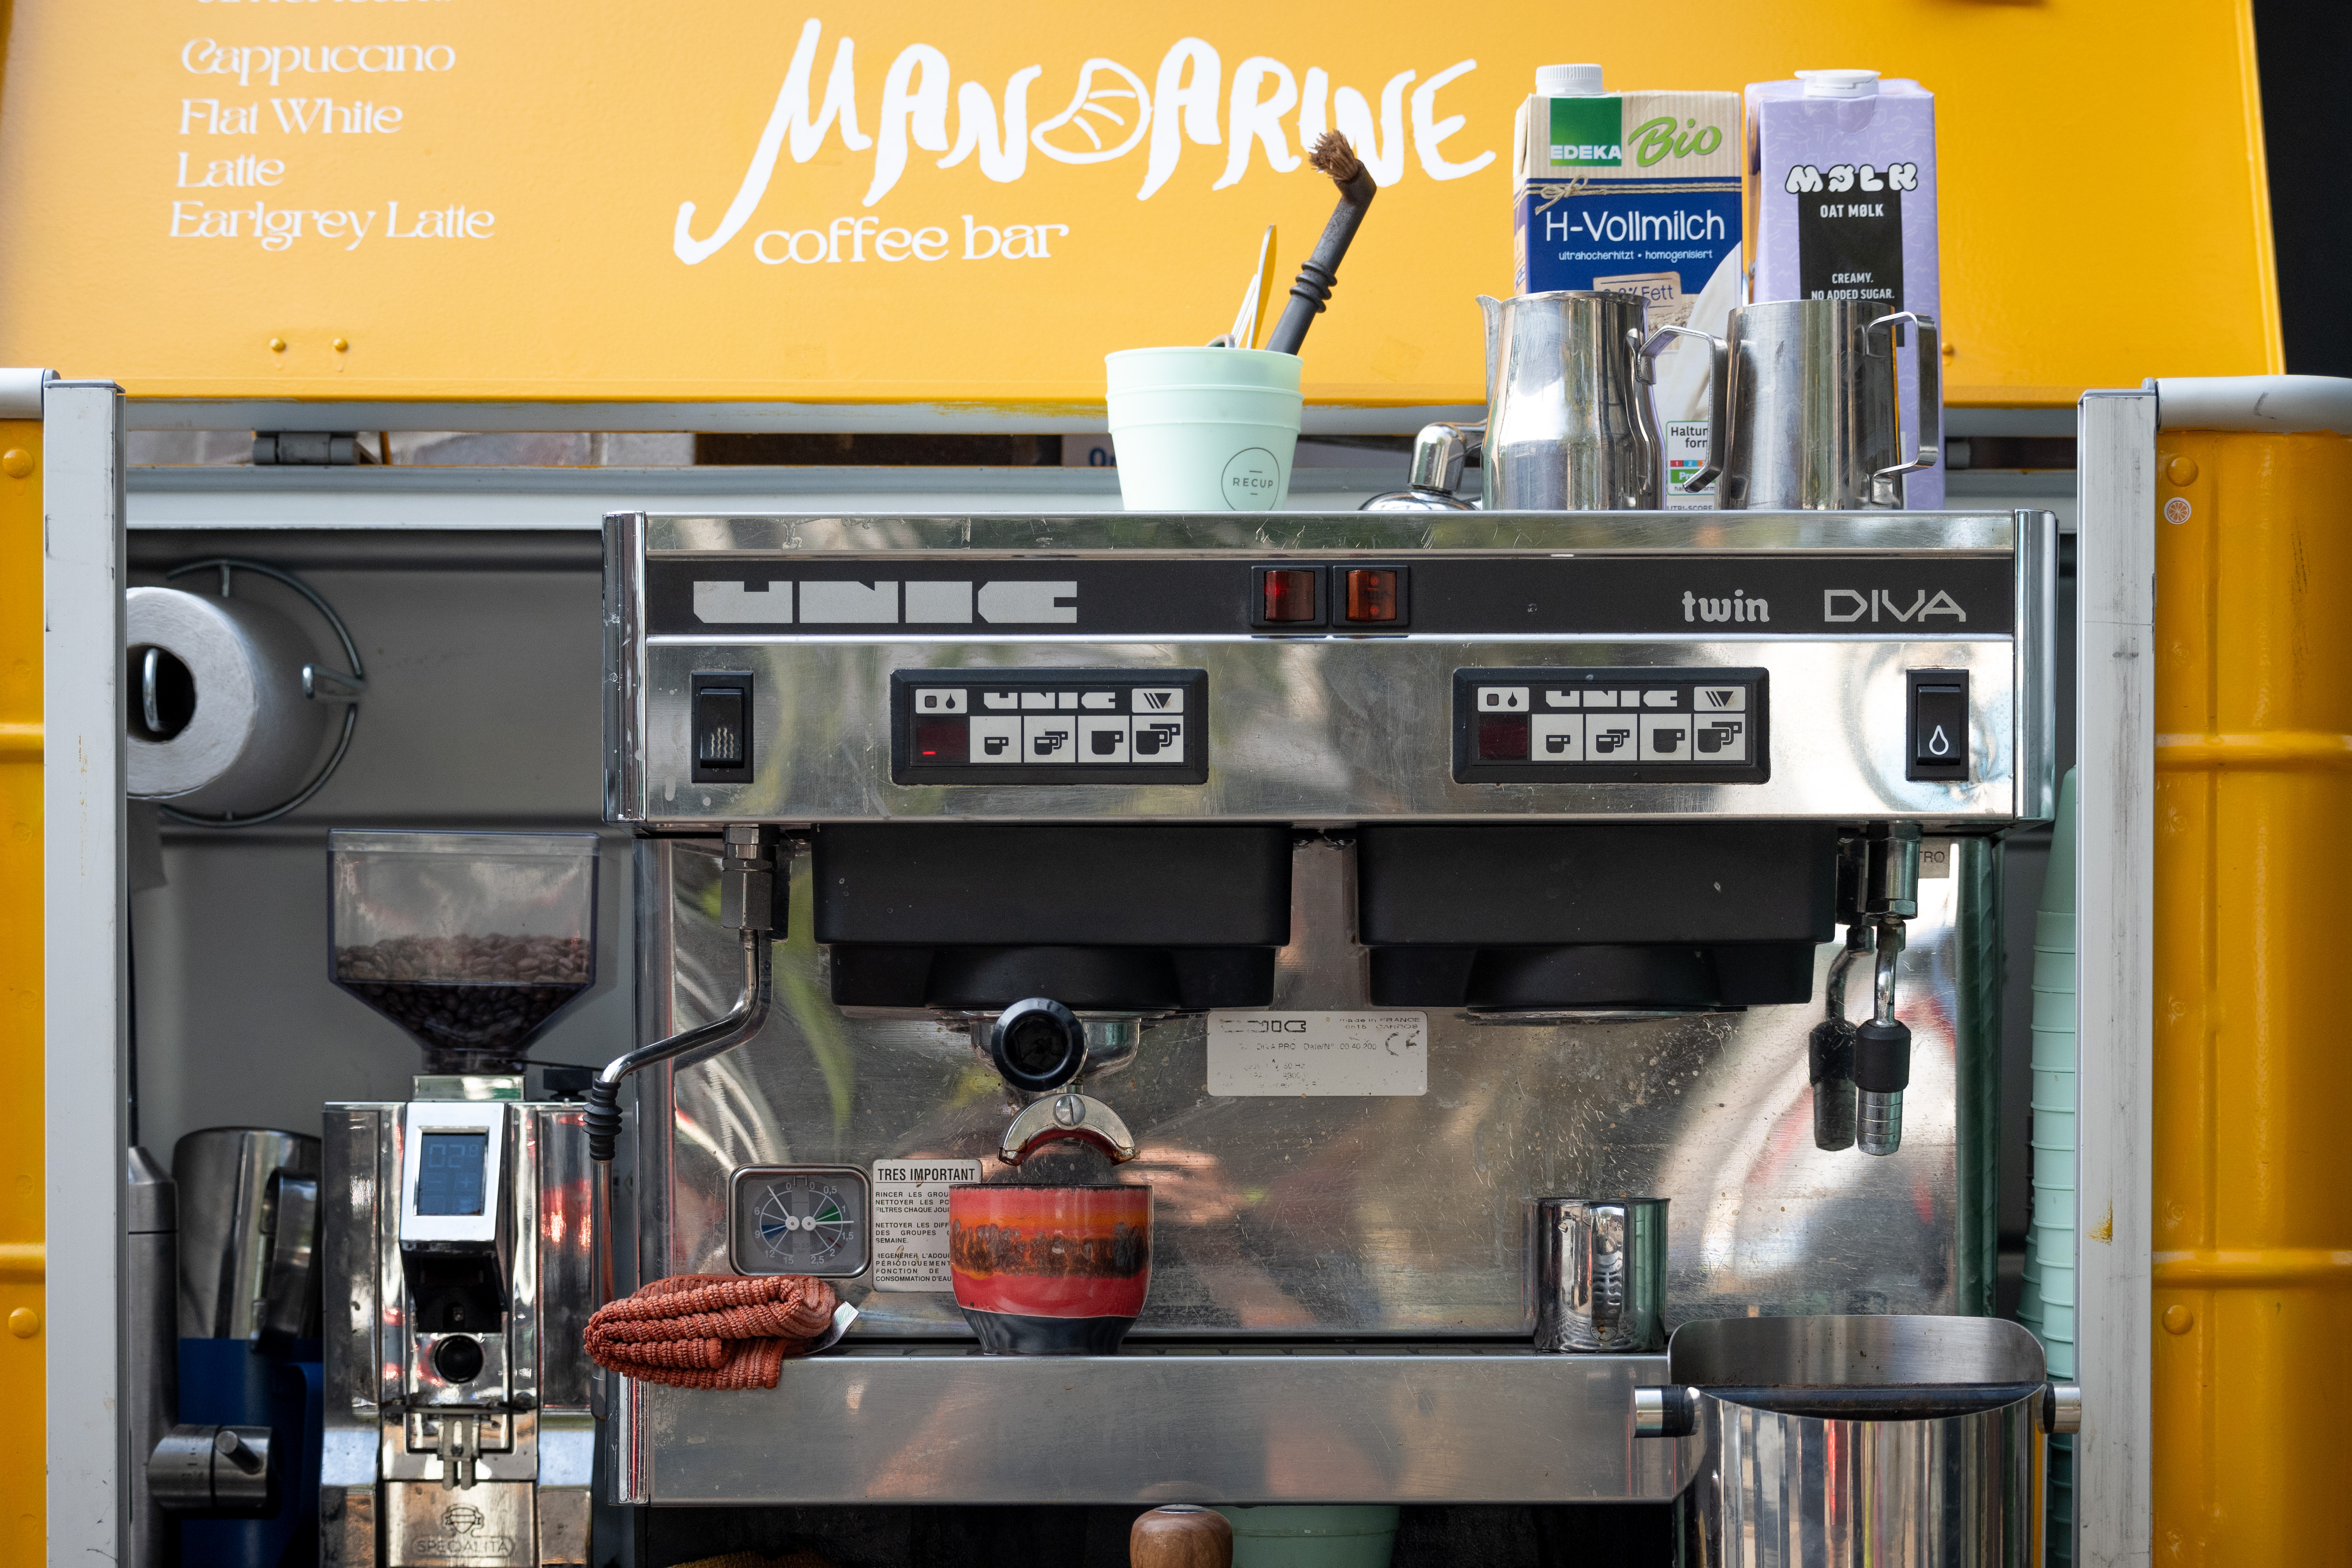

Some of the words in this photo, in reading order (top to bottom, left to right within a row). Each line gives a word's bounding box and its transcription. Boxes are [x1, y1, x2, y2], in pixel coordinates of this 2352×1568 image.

[180, 37, 456, 86] Cappuccino
[179, 98, 259, 135] Flat
[270, 98, 403, 134] White
[1628, 116, 1722, 166] Bio
[1550, 145, 1622, 159] EDEKA
[176, 151, 285, 188] Latte
[1820, 204, 1844, 218] OAT
[169, 201, 377, 251] Earlgrey
[386, 201, 495, 238] Latte
[1546, 210, 1725, 241] H-Vollmilch
[754, 216, 949, 265] coffee
[961, 214, 1069, 259] bar
[1559, 251, 1634, 261] ultrahocherhitzt
[1645, 250, 1713, 263] homogenisiert
[1832, 272, 1874, 284] CREAMY.
[1641, 285, 1674, 301] Fett
[1812, 290, 1824, 300] NO
[1827, 290, 1858, 300] ADDED
[1861, 289, 1895, 300] SUGAR.
[1233, 477, 1273, 488] RECUP
[1682, 589, 1770, 622] twin
[1824, 589, 1966, 622] DIVA
[878, 1168, 906, 1181] TRES
[910, 1168, 975, 1181] IMPORTANT
[841, 1205, 846, 1213] 1
[755, 1230, 760, 1238] 9
[829, 1248, 835, 1257] 2
